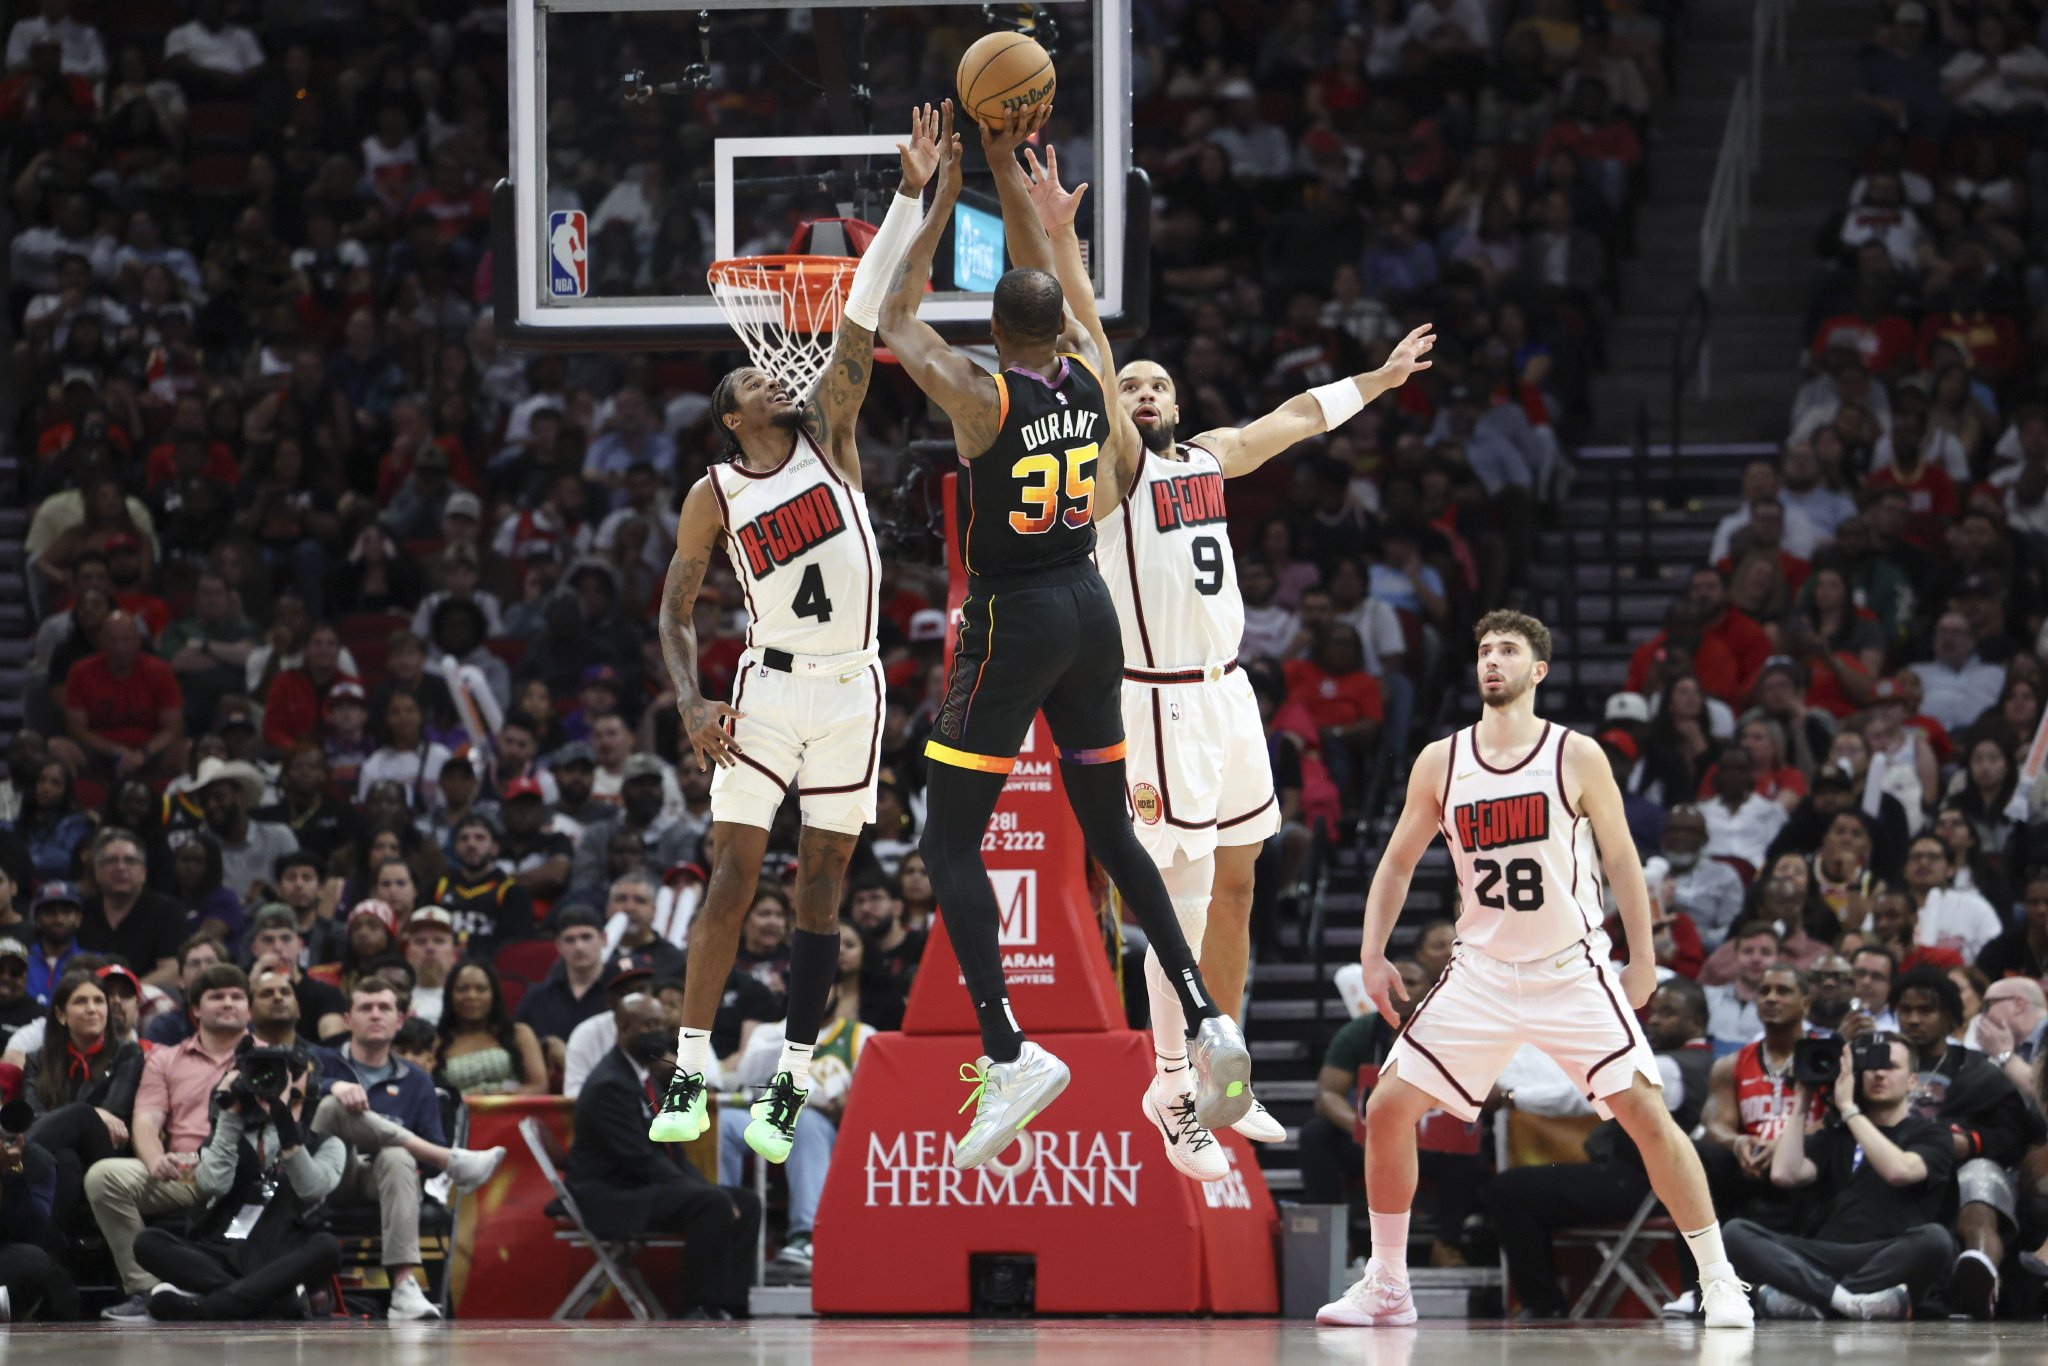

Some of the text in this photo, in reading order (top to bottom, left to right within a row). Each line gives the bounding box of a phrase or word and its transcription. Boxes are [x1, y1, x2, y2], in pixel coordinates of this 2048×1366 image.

[1002, 77, 1055, 112] Wilson
[555, 278, 573, 293] NBA
[1020, 409, 1099, 451] DURANT
[1009, 441, 1099, 535] 35
[1191, 536, 1224, 595] 9
[791, 562, 833, 624] 4
[1011, 760, 1053, 776] RAM
[989, 812, 1018, 832] 281
[1473, 857, 1545, 912] 28
[864, 1166, 1139, 1207] HERMANN
